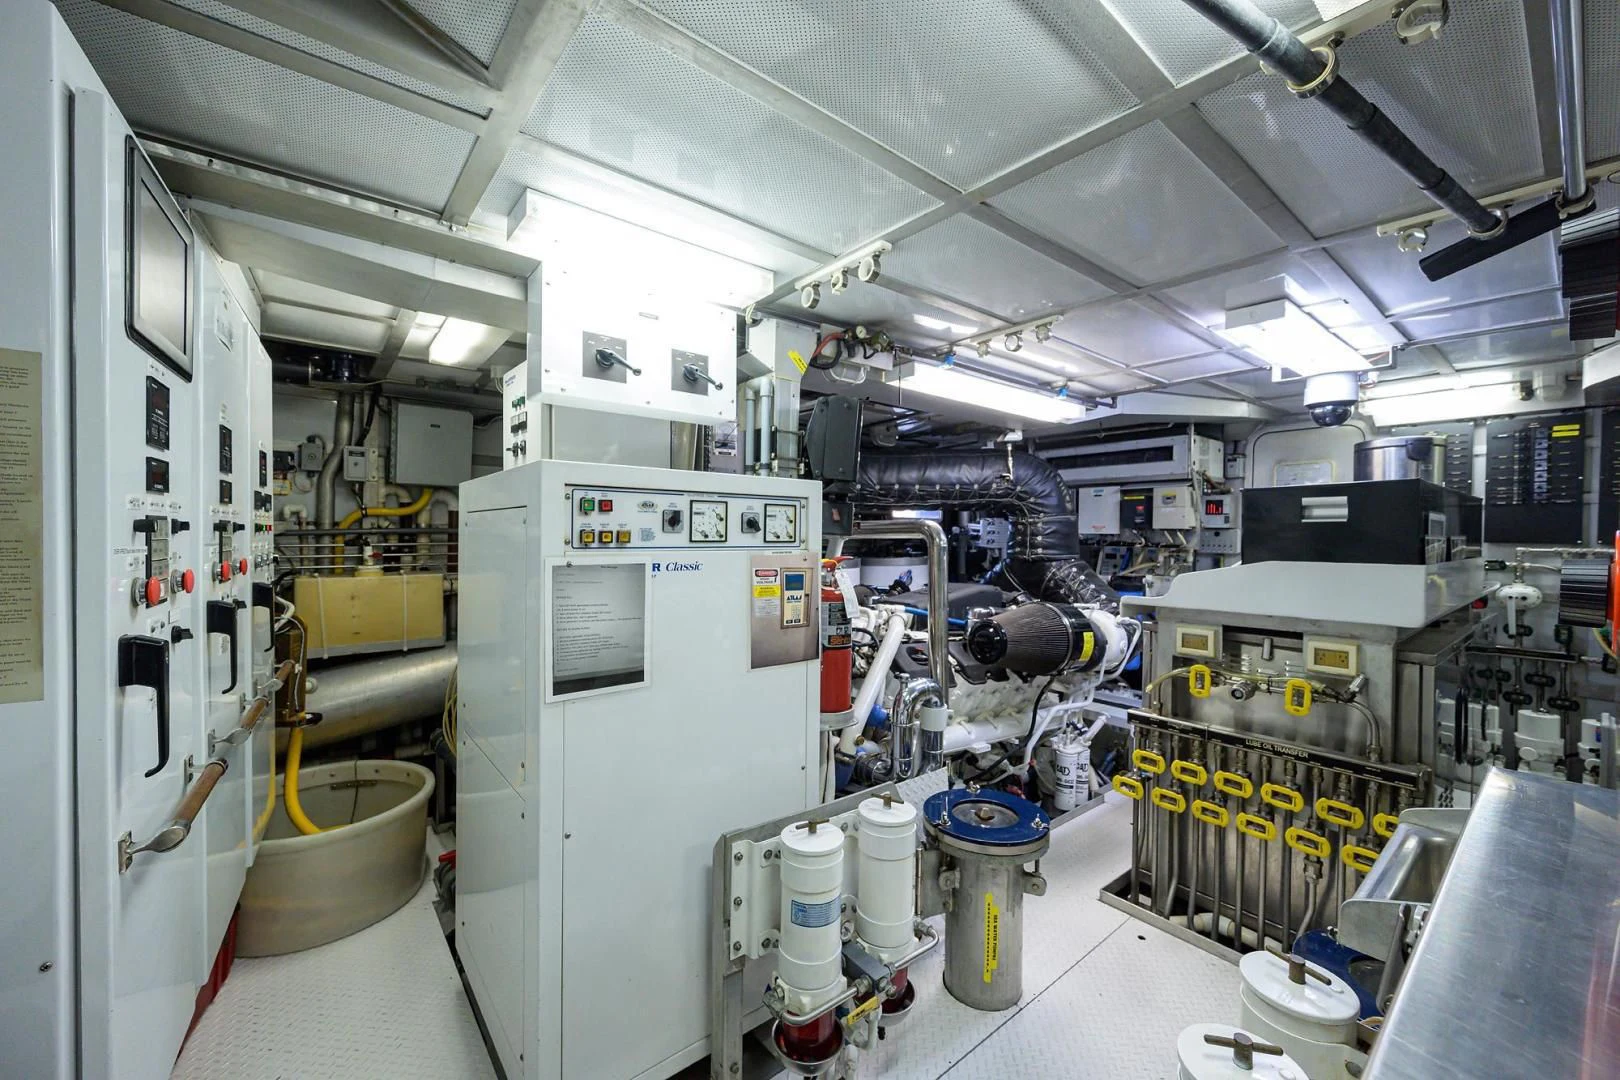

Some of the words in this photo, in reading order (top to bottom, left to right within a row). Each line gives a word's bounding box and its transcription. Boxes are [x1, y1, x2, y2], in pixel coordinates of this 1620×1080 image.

[666, 561, 704, 572] Classic
[1245, 738, 1262, 747] LUBE
[1274, 746, 1308, 758] TRANSFER
